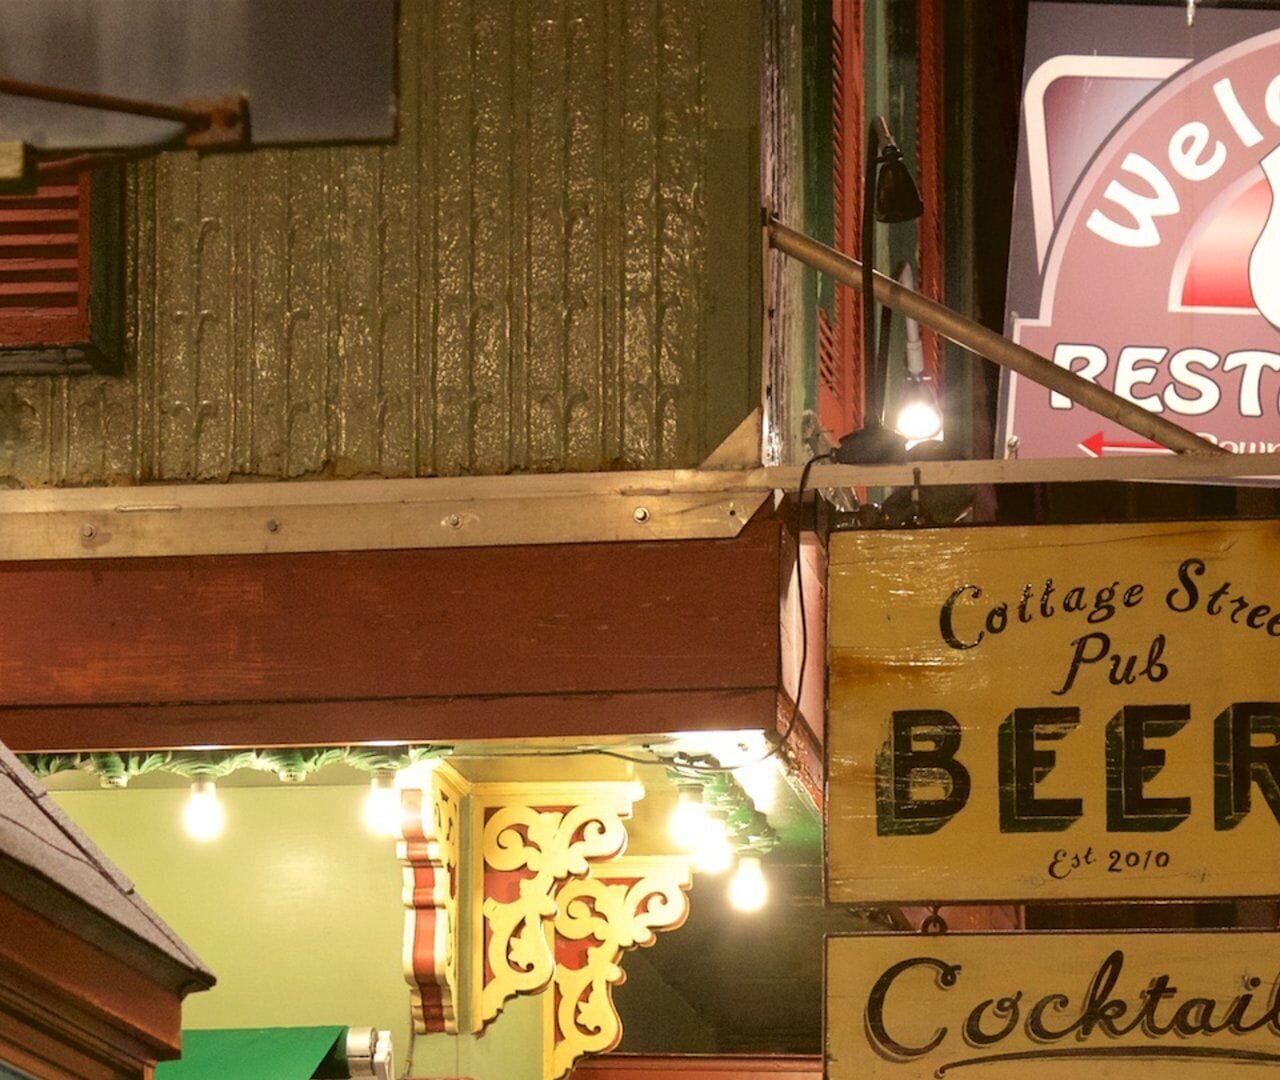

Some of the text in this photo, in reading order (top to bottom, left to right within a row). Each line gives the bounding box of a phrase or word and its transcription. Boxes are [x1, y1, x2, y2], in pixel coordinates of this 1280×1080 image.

[939, 577, 1145, 650] Cottage
[1051, 632, 1169, 695] Pub
[1107, 850, 1171, 873] 2010
